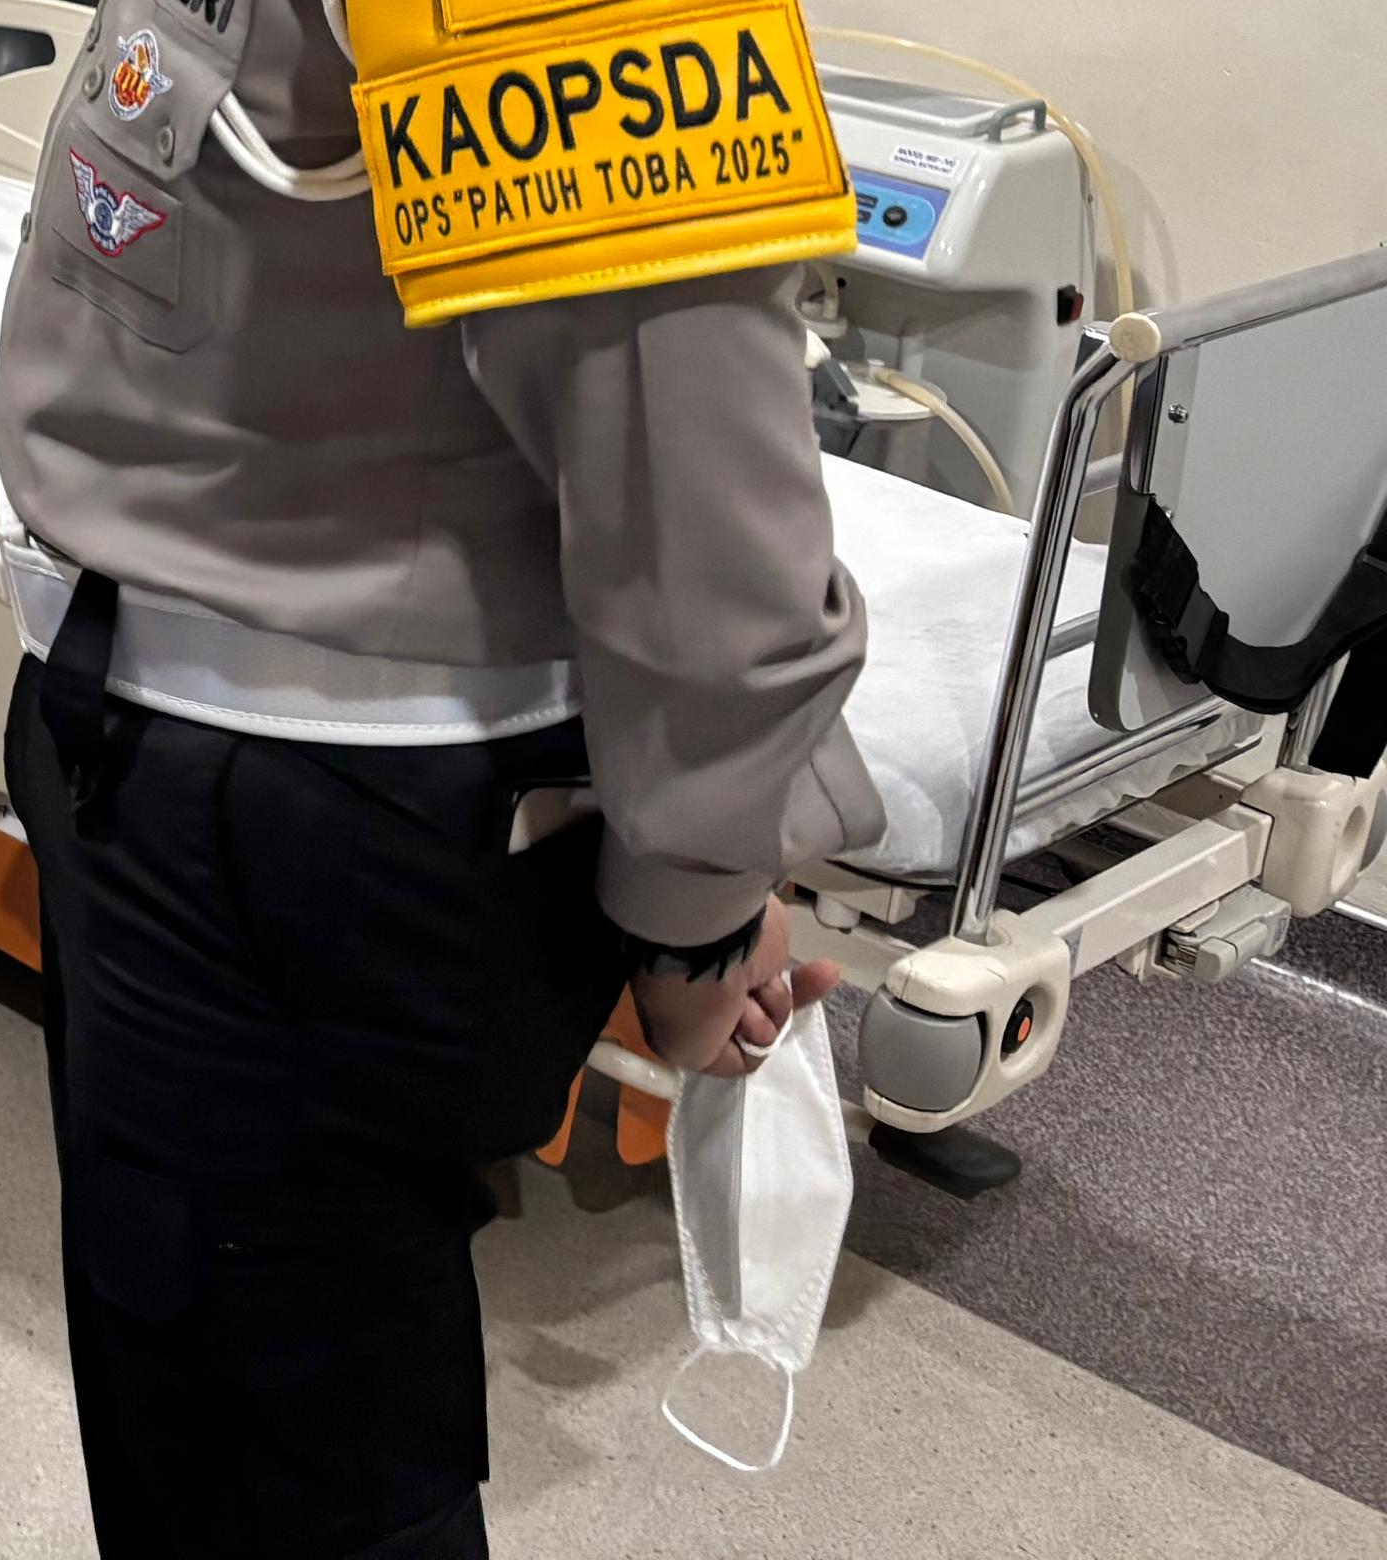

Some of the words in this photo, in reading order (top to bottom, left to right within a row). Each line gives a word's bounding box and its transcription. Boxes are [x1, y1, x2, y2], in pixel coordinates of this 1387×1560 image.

[380, 29, 792, 189] KAOPSDA
[596, 147, 696, 204] TOBA
[711, 129, 804, 185] 2025"
